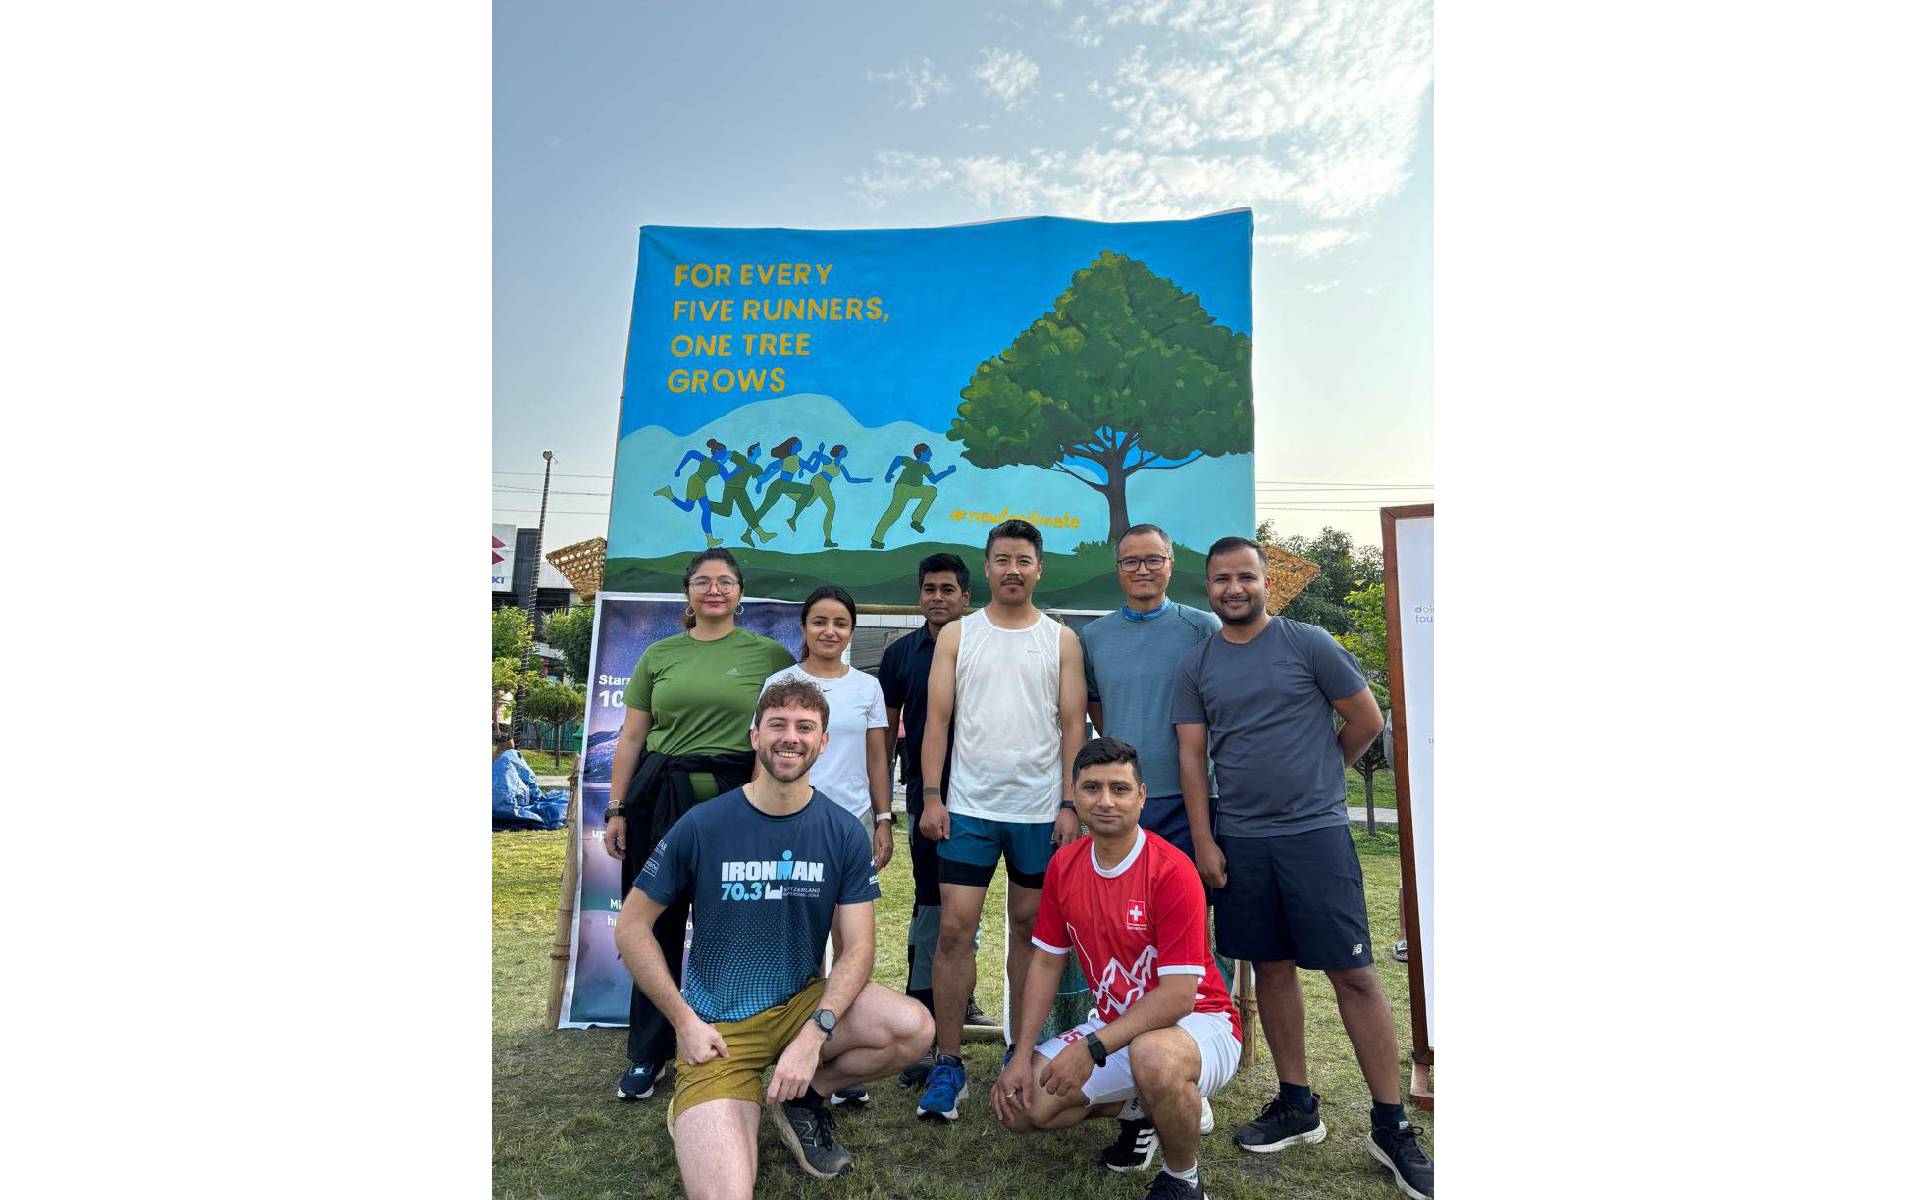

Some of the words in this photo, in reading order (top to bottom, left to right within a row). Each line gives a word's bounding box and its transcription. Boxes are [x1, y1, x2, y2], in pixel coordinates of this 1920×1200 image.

[674, 263, 732, 288] FOR
[740, 263, 833, 285] EVERY
[673, 300, 734, 321] FIVE
[742, 297, 889, 323] RUNNERS,
[671, 334, 733, 358] ONE
[742, 333, 811, 356] TREE
[668, 368, 786, 393] GROWS
[721, 856, 824, 882] IRONMAN
[721, 882, 763, 901] 70.3
